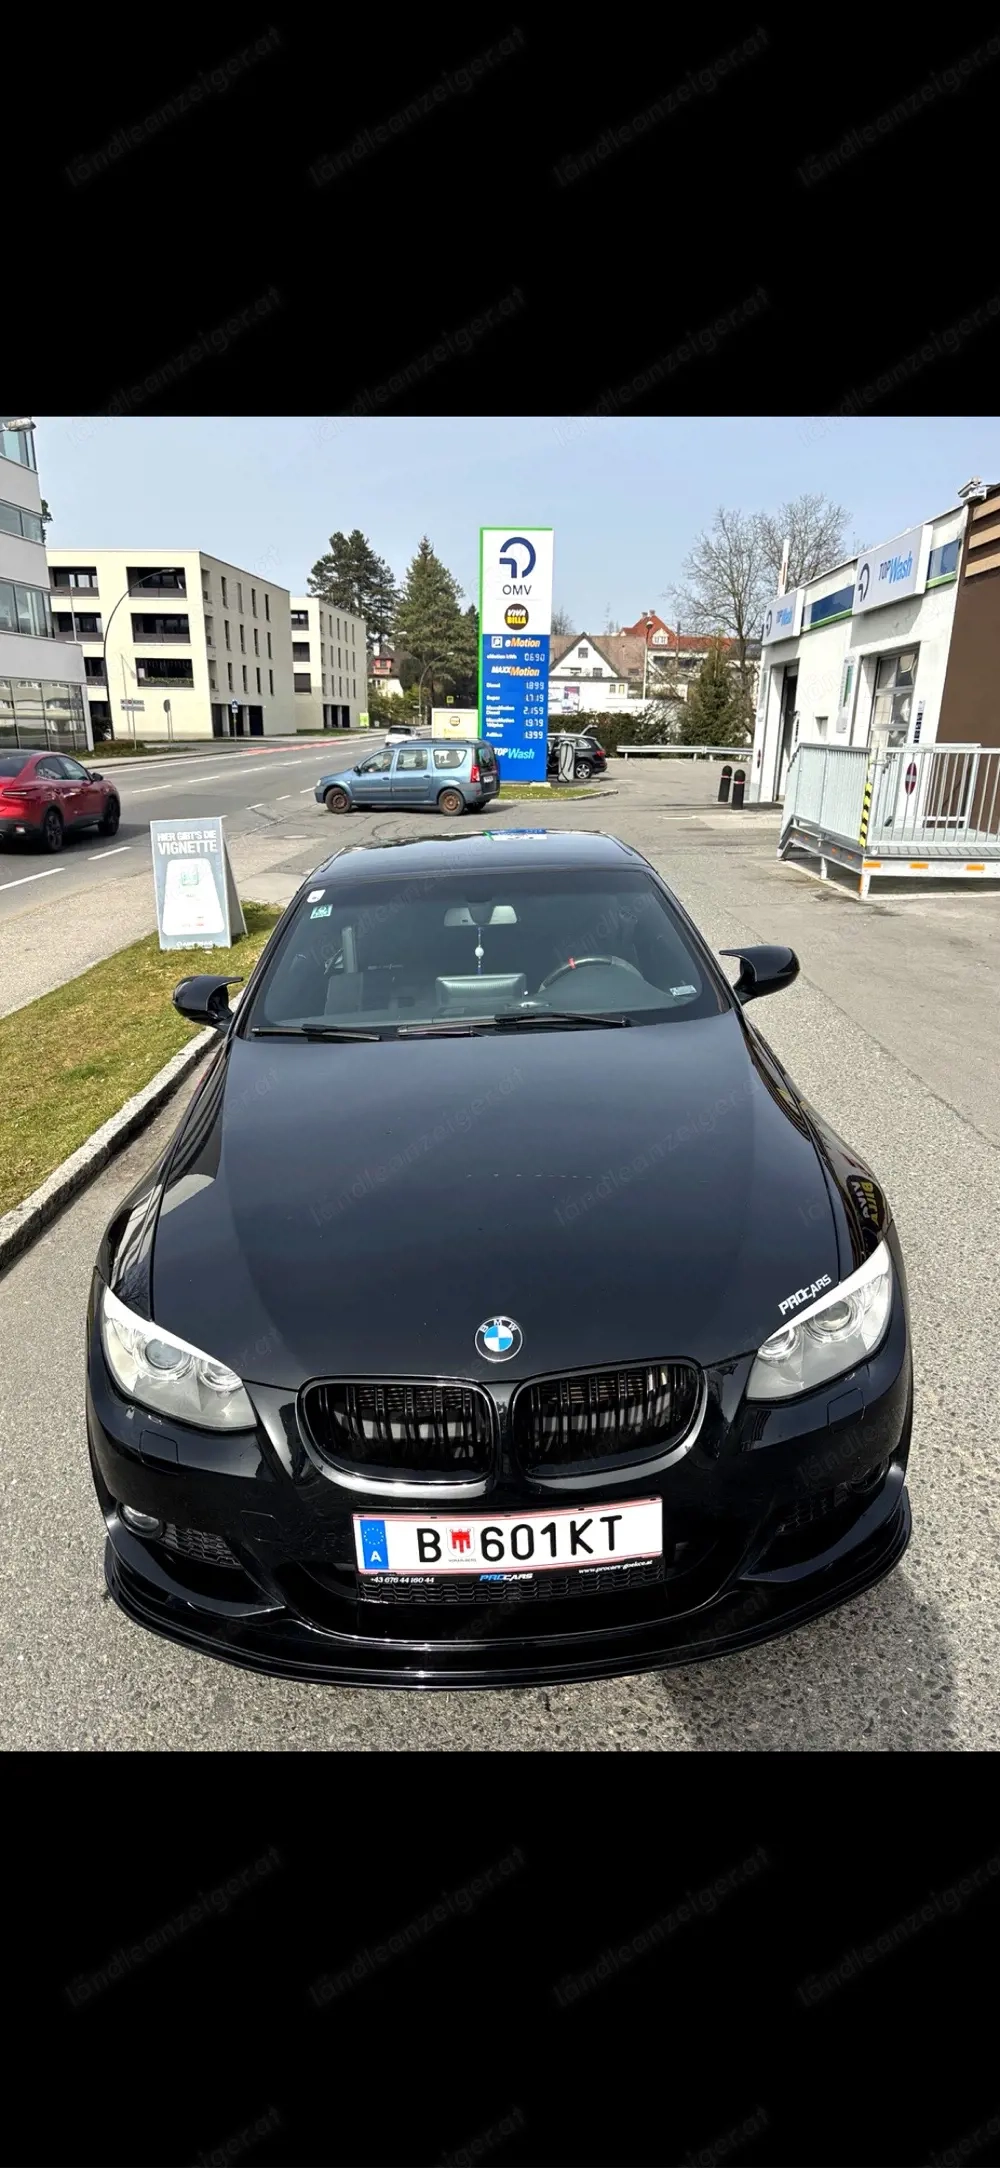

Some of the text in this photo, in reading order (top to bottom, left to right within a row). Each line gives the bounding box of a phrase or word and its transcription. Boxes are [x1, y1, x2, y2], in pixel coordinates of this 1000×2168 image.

[502, 584, 532, 595] OMV
[507, 609, 526, 617] VIVA
[507, 616, 526, 624] BILLA
[505, 637, 541, 647] eMotion
[156, 830, 217, 842] HIER GIBT'S DIE
[157, 840, 218, 855] VIGNETTE
[778, 1273, 832, 1315] PROCARS
[479, 1318, 518, 1333] BMW
[370, 1514, 623, 1563] A B 601KT
[479, 1572, 534, 1581] PROCARS
